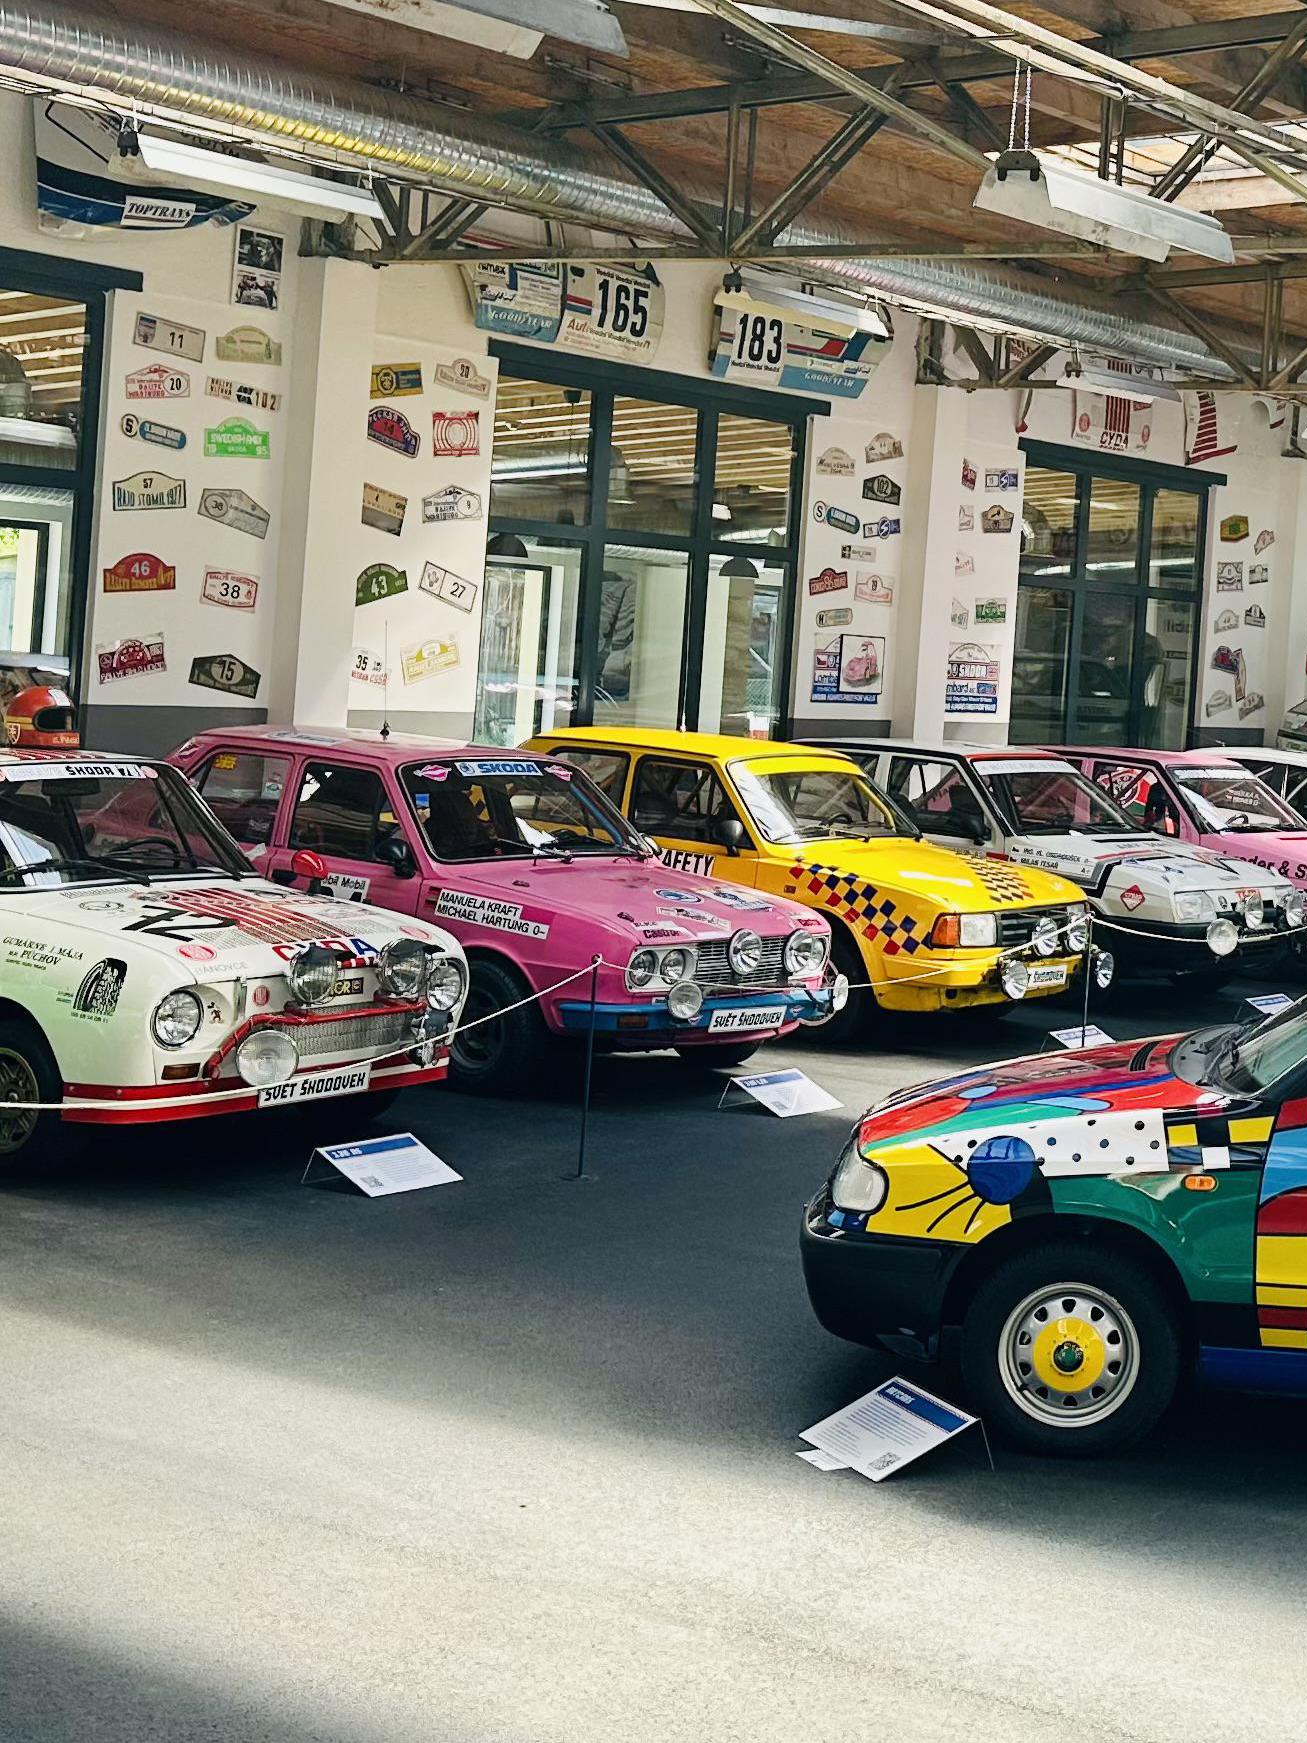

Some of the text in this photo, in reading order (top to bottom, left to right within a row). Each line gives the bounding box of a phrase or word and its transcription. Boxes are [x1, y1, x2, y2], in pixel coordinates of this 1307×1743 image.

[126, 201, 193, 219] TOPTRANS
[598, 278, 649, 338] 165
[169, 331, 184, 349] 11
[737, 314, 783, 364] 183
[169, 378, 182, 391] 20
[254, 391, 277, 411] 102
[142, 477, 154, 489] 57
[130, 561, 150, 577] 46
[219, 582, 241, 599] 38
[371, 575, 388, 597] 43
[450, 582, 467, 599] 27
[355, 654, 369, 671] 35
[661, 850, 715, 877] AFETY
[1278, 860, 1290, 877] &
[341, 875, 367, 889] Mobil
[440, 891, 521, 917] MANUELA KRAFT
[437, 903, 479, 923] MICHAEL
[480, 913, 530, 934] HARTUNG
[271, 938, 382, 961] CDA
[738, 1011, 783, 1027] ŠKODOVEK
[300, 1071, 367, 1096] ŠKODOVEK
